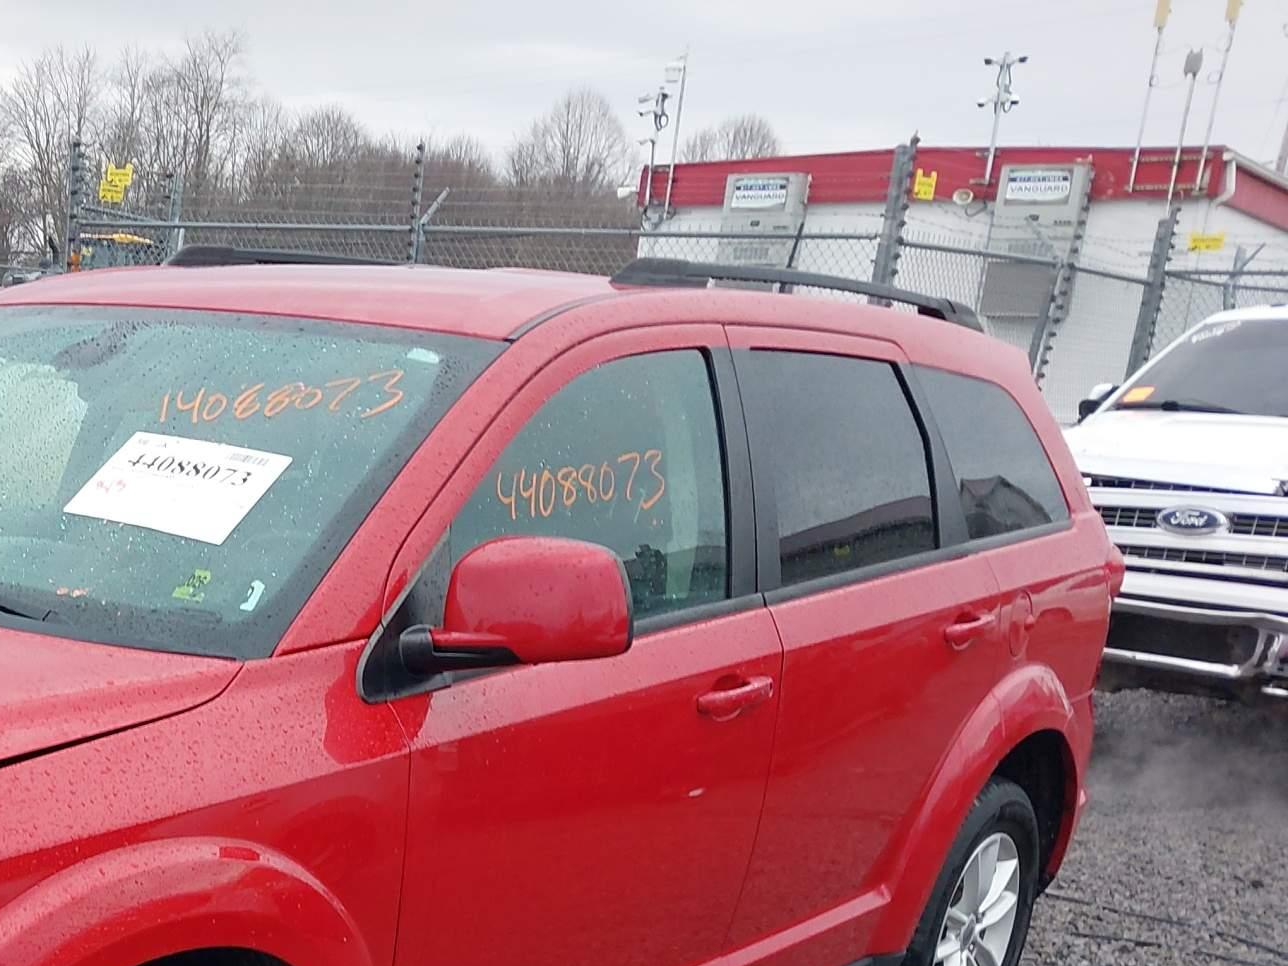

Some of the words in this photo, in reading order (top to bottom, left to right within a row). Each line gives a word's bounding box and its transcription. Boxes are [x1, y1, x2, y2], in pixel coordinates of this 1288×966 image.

[128, 453, 253, 486] 44088073
[497, 449, 665, 521] 44088073
[1169, 511, 1208, 527] Ford
